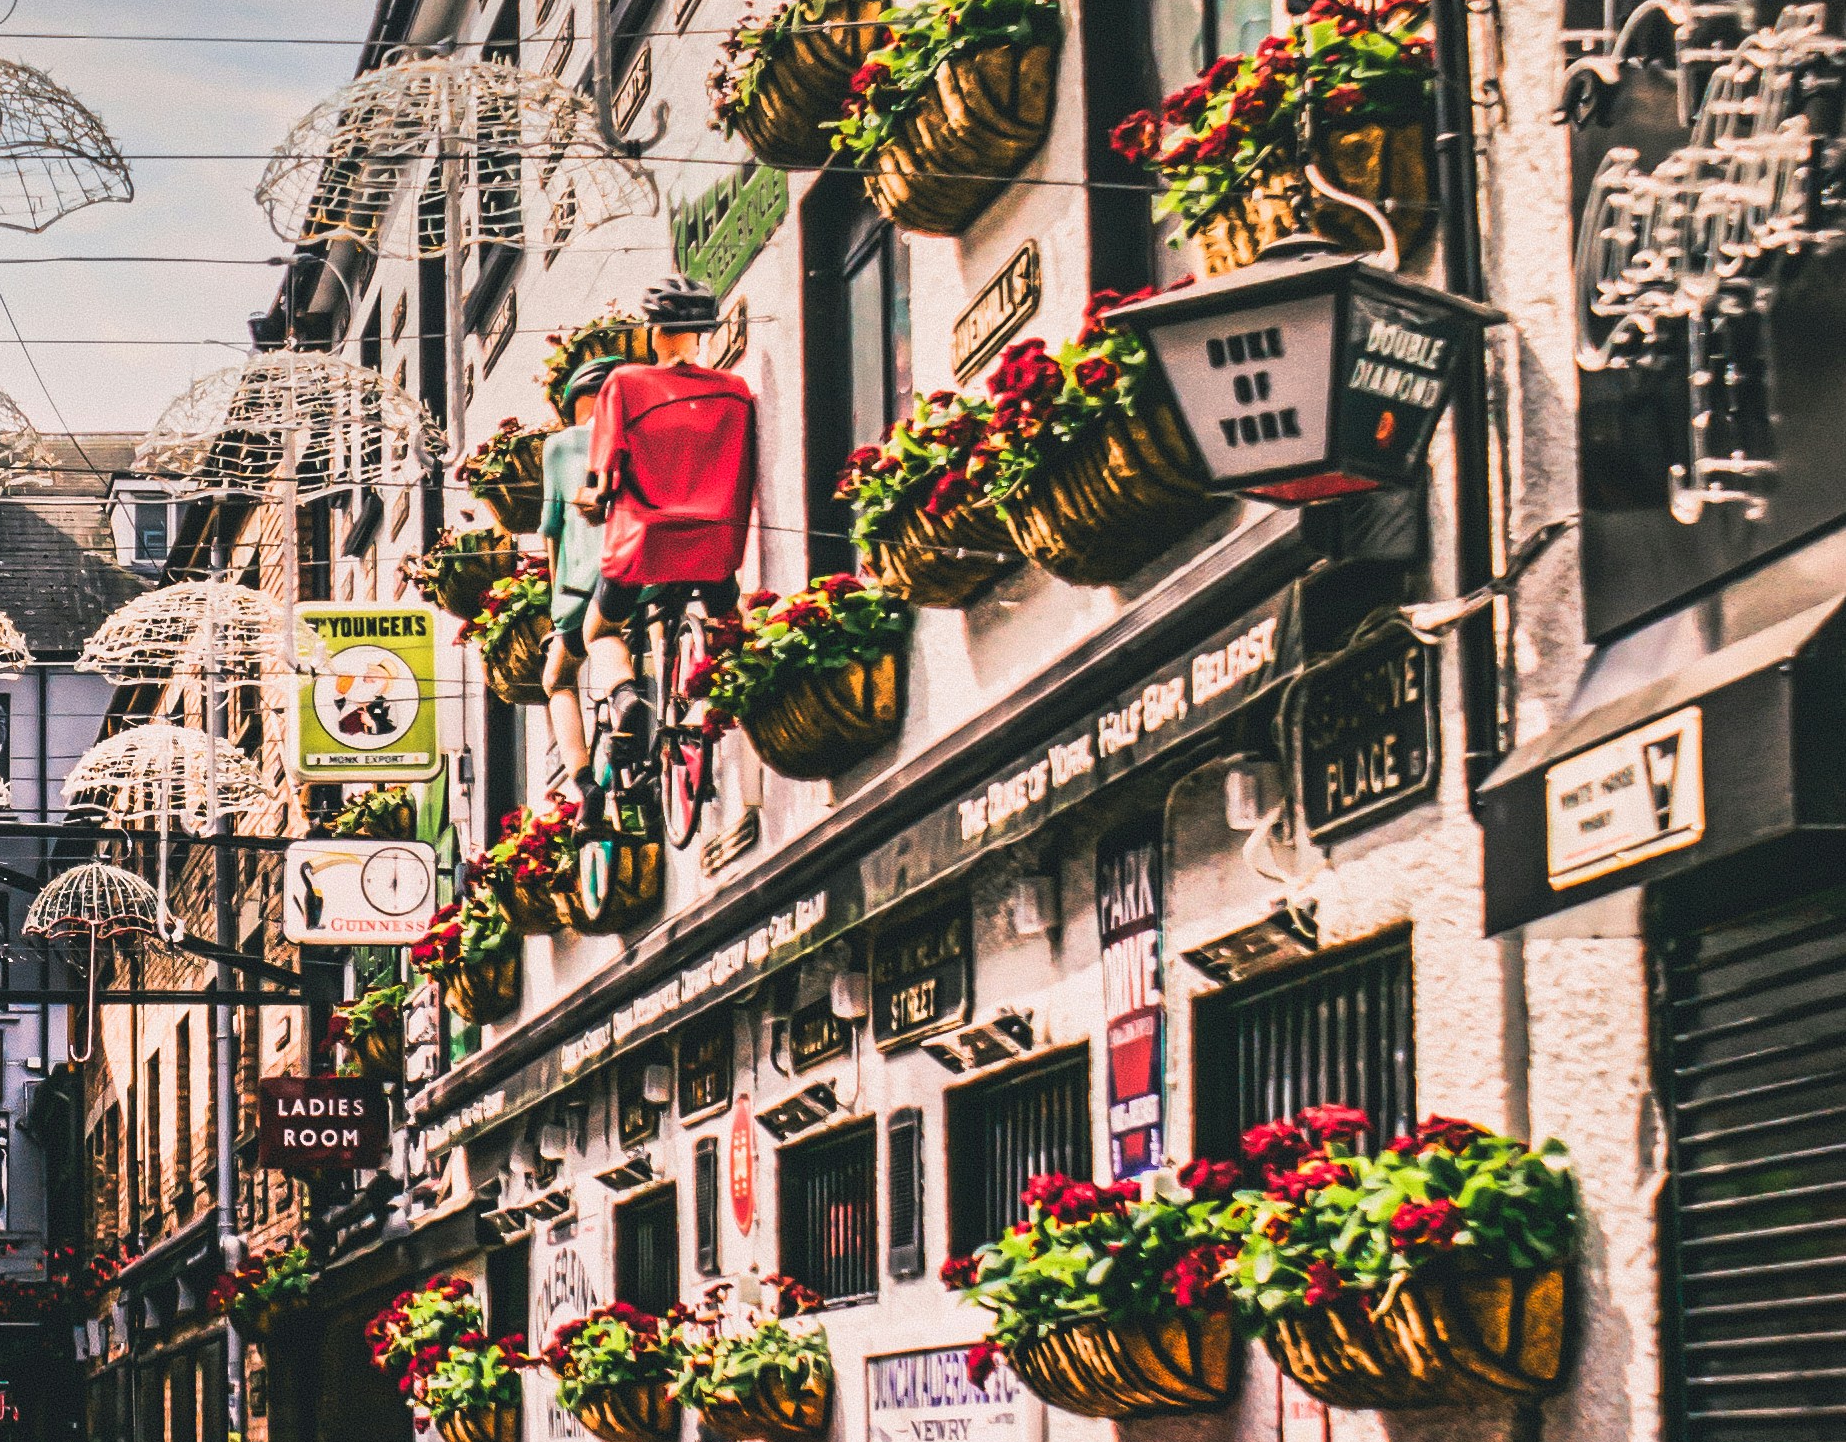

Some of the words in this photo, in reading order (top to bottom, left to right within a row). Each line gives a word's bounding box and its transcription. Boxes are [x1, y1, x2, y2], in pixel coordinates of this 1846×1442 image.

[1206, 327, 1285, 369] DUKE
[1365, 319, 1447, 371] DOUBLE
[1232, 370, 1271, 405] OF
[1348, 358, 1443, 409] DIAMOND
[1219, 407, 1301, 448] YORK
[959, 796, 988, 841] THE
[987, 771, 1030, 826] DUKE
[1027, 759, 1049, 803] OF
[1048, 733, 1095, 789] YORK
[1097, 699, 1142, 758] HALF
[1191, 616, 1277, 706] BELFAST
[328, 755, 358, 764] MONK
[364, 754, 405, 764] EXPORT
[1326, 734, 1400, 815] PLACE
[1100, 849, 1155, 935] PARK
[330, 917, 426, 933] GUINNESS
[890, 977, 937, 1032] STREET
[278, 1097, 364, 1118] LADIES
[283, 1128, 360, 1148] ROOM
[910, 1417, 973, 1442] NEWRY
